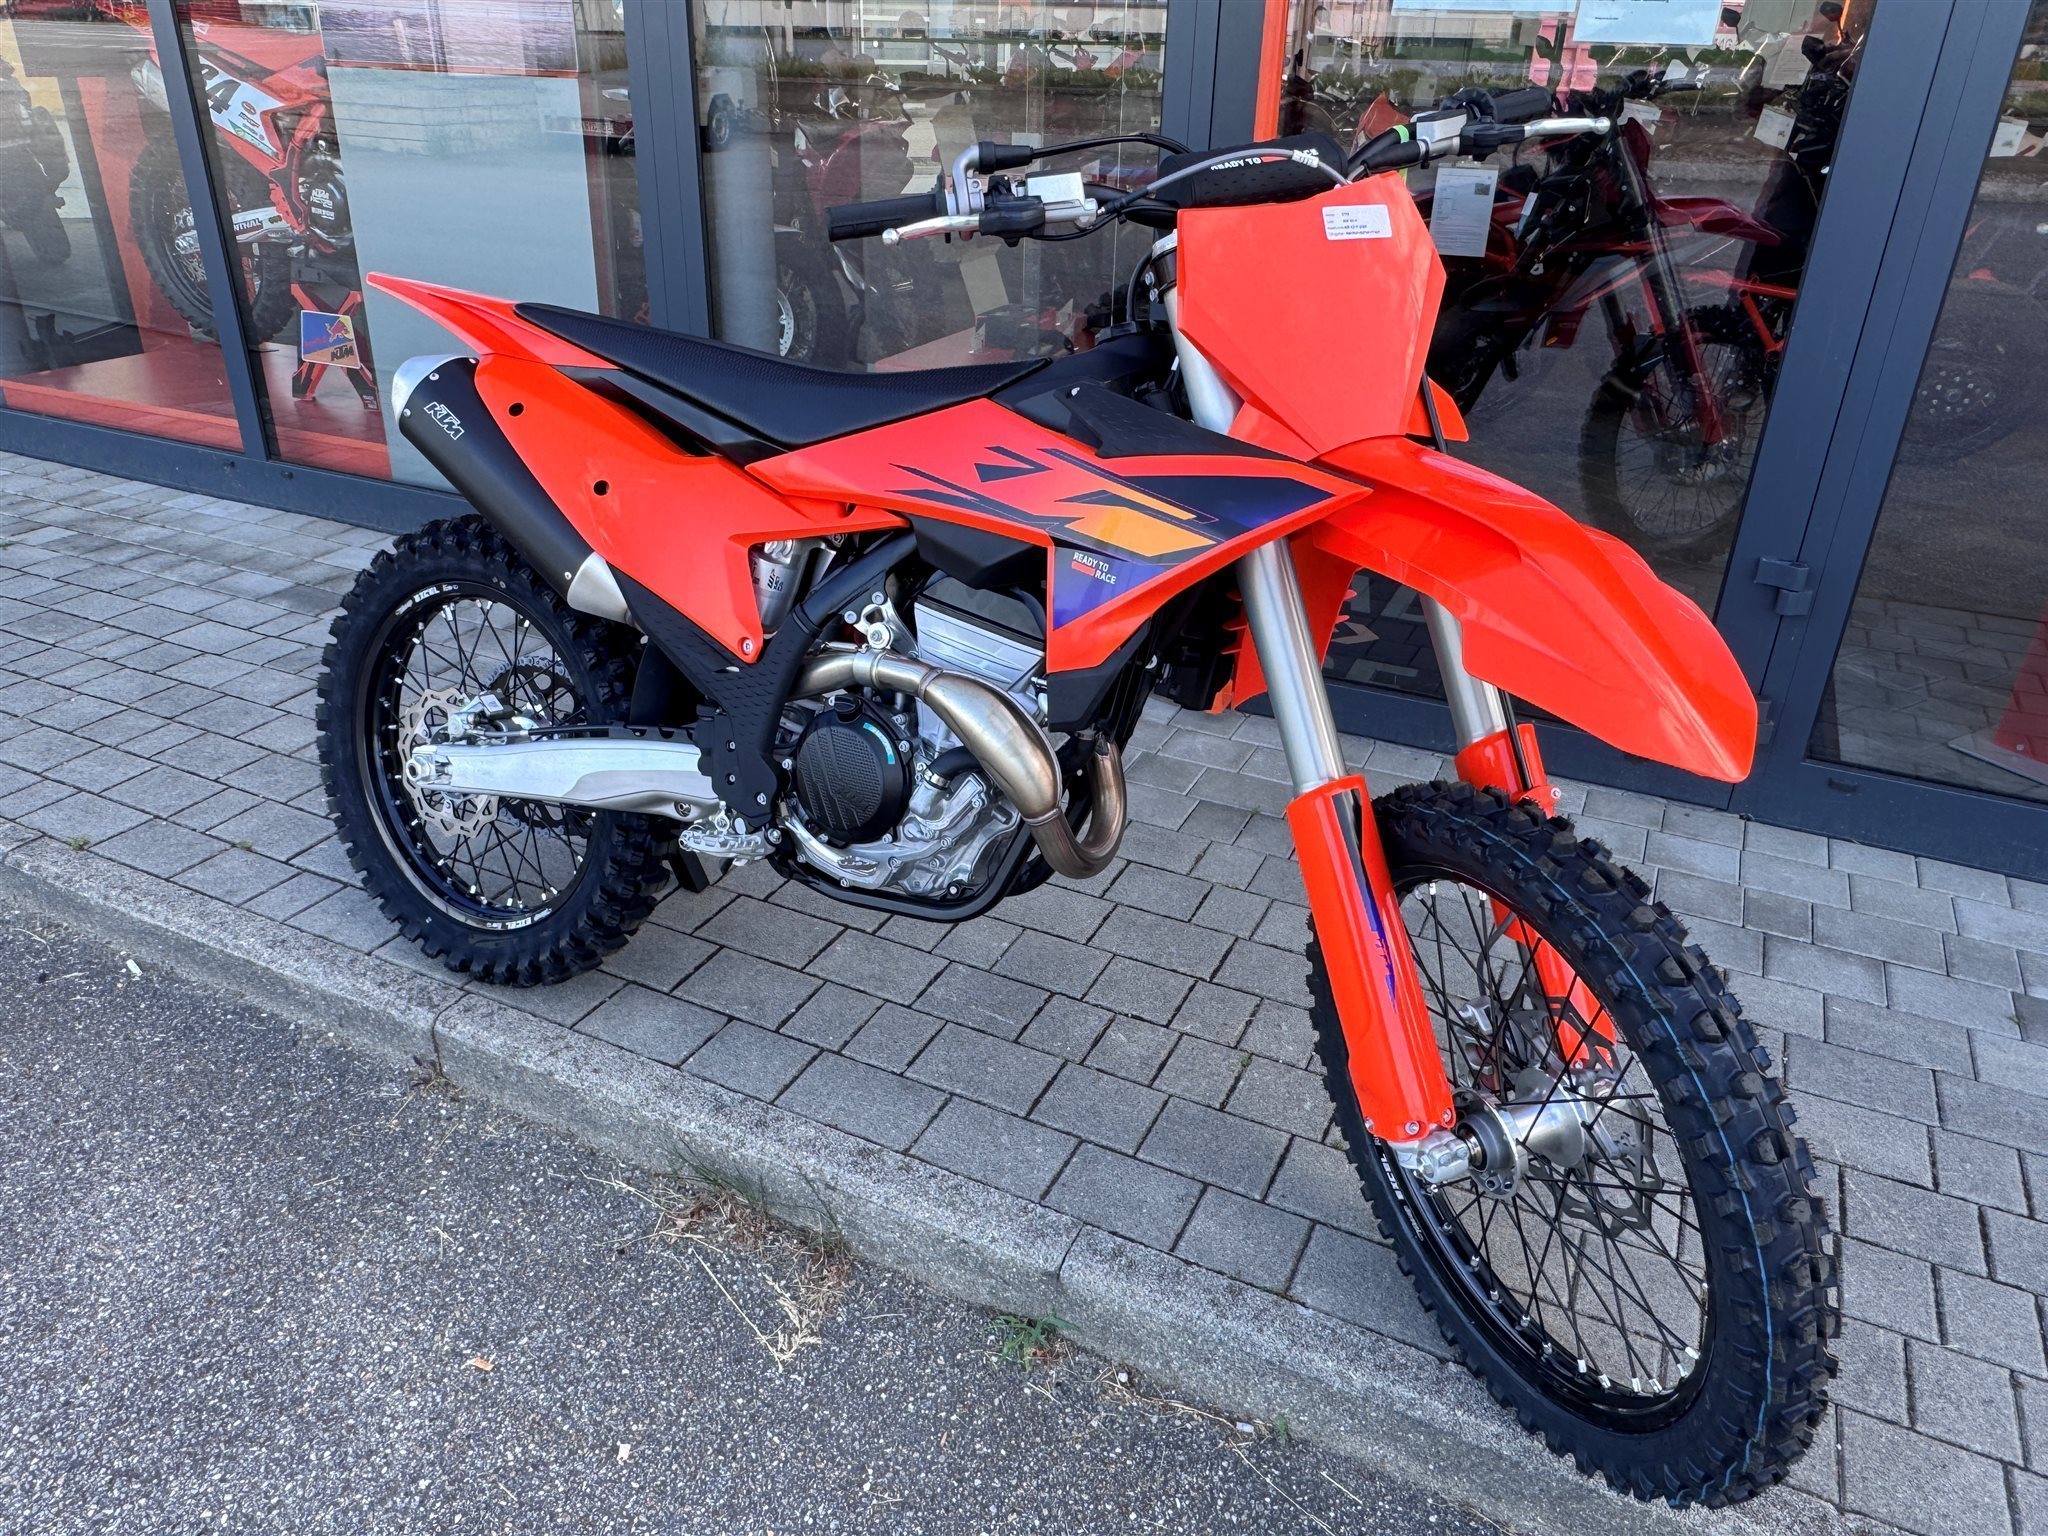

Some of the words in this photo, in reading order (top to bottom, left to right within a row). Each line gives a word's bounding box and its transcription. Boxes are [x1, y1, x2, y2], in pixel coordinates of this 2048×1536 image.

[1246, 157, 1261, 166] TO
[331, 344, 354, 361] KTM
[423, 401, 465, 441] KTM
[1073, 552, 1097, 567] READY
[1098, 561, 1109, 571] TO
[1095, 570, 1116, 584] RACE
